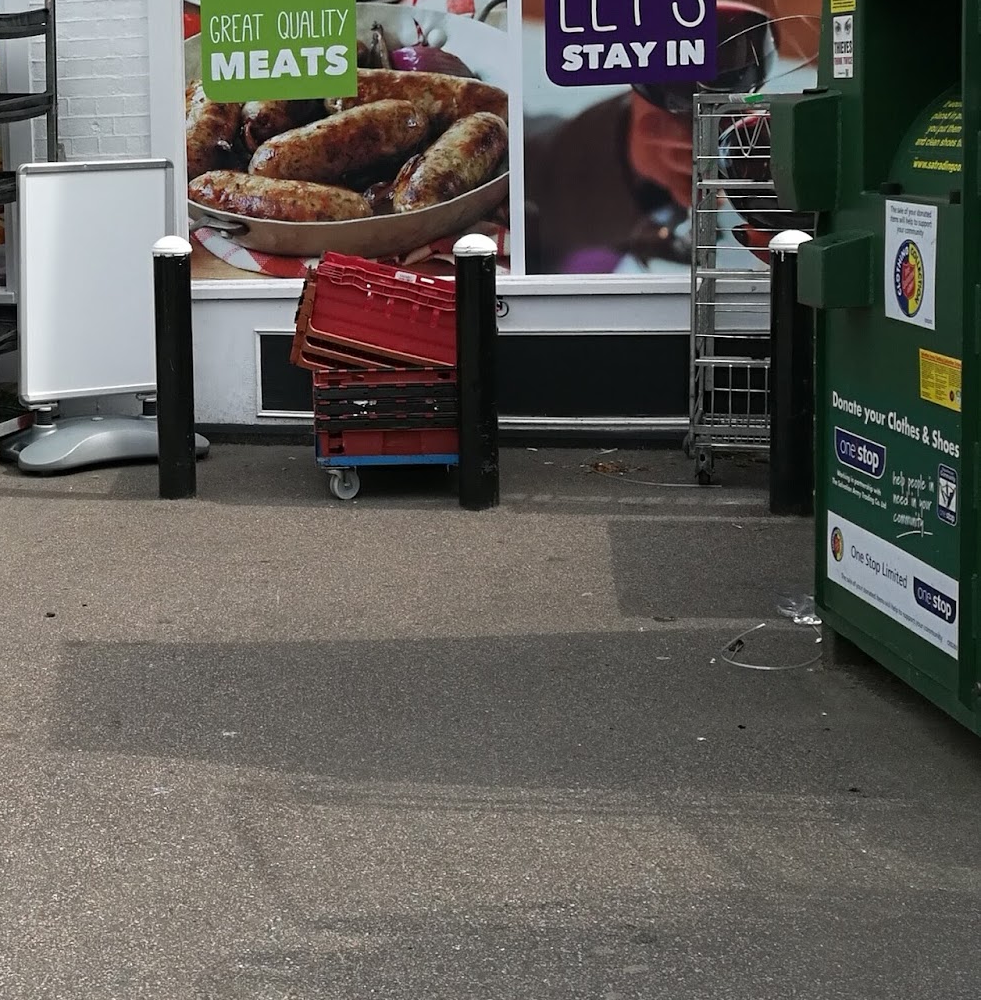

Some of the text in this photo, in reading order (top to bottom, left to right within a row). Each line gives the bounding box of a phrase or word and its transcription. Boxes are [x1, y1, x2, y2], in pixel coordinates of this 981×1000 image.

[209, 8, 349, 44] GREAT QUALITY
[210, 45, 349, 81] MEATS
[561, 39, 705, 71] STAY IN
[834, 41, 853, 54] THIEVES
[917, 209, 932, 218] donated
[918, 220, 932, 228] support
[905, 228, 924, 238] community
[895, 246, 910, 297] CLOTHING
[909, 246, 924, 306] COLLECTION
[832, 390, 960, 458] Donate your Clothes & Shoes
[839, 439, 880, 474] one stop
[892, 470, 934, 497] help people in
[893, 491, 933, 518] need in your
[893, 512, 924, 537] community
[851, 545, 908, 589] One Stop Limited
[917, 586, 952, 620] one stop
